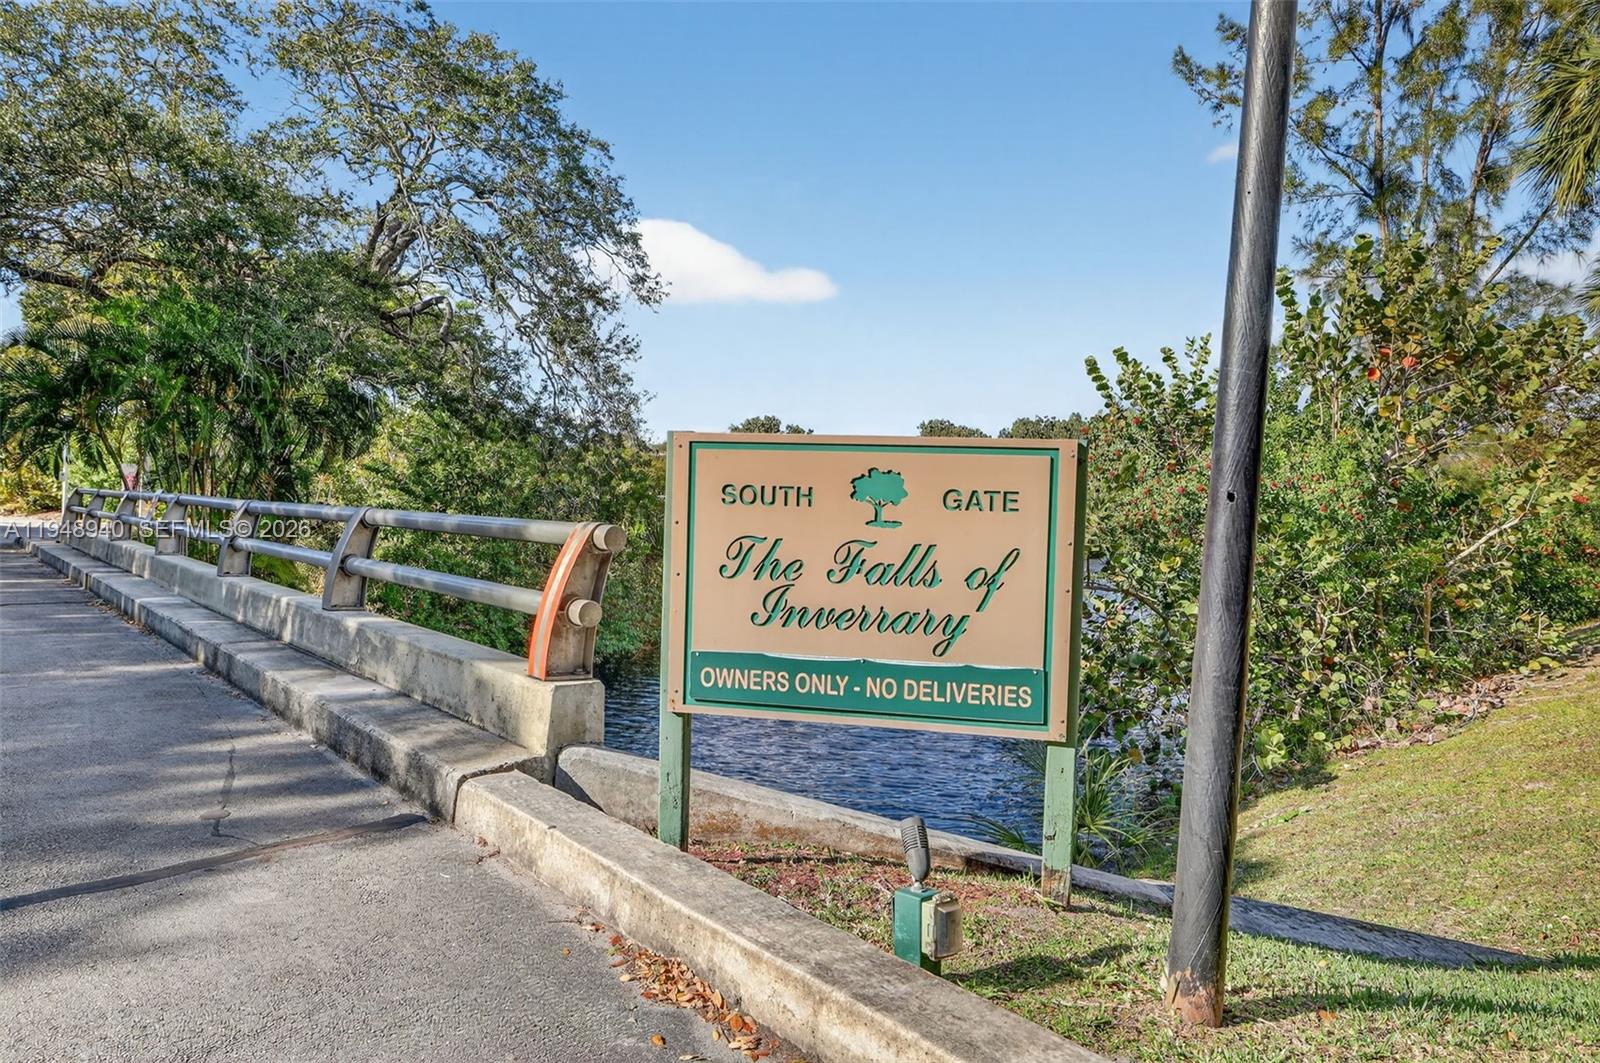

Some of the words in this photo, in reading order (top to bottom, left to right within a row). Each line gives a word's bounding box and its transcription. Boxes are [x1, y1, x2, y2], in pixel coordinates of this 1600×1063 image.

[721, 483, 814, 508] SOUTH
[943, 488, 1020, 513] GATE
[719, 535, 805, 582] The
[826, 539, 942, 588] Falls
[964, 547, 1022, 612] of
[750, 583, 971, 657] Inverrary
[700, 667, 790, 693] OWNERS
[794, 672, 850, 697] ONLY
[866, 676, 898, 700] NO
[903, 679, 1032, 708] DELIVERIES
